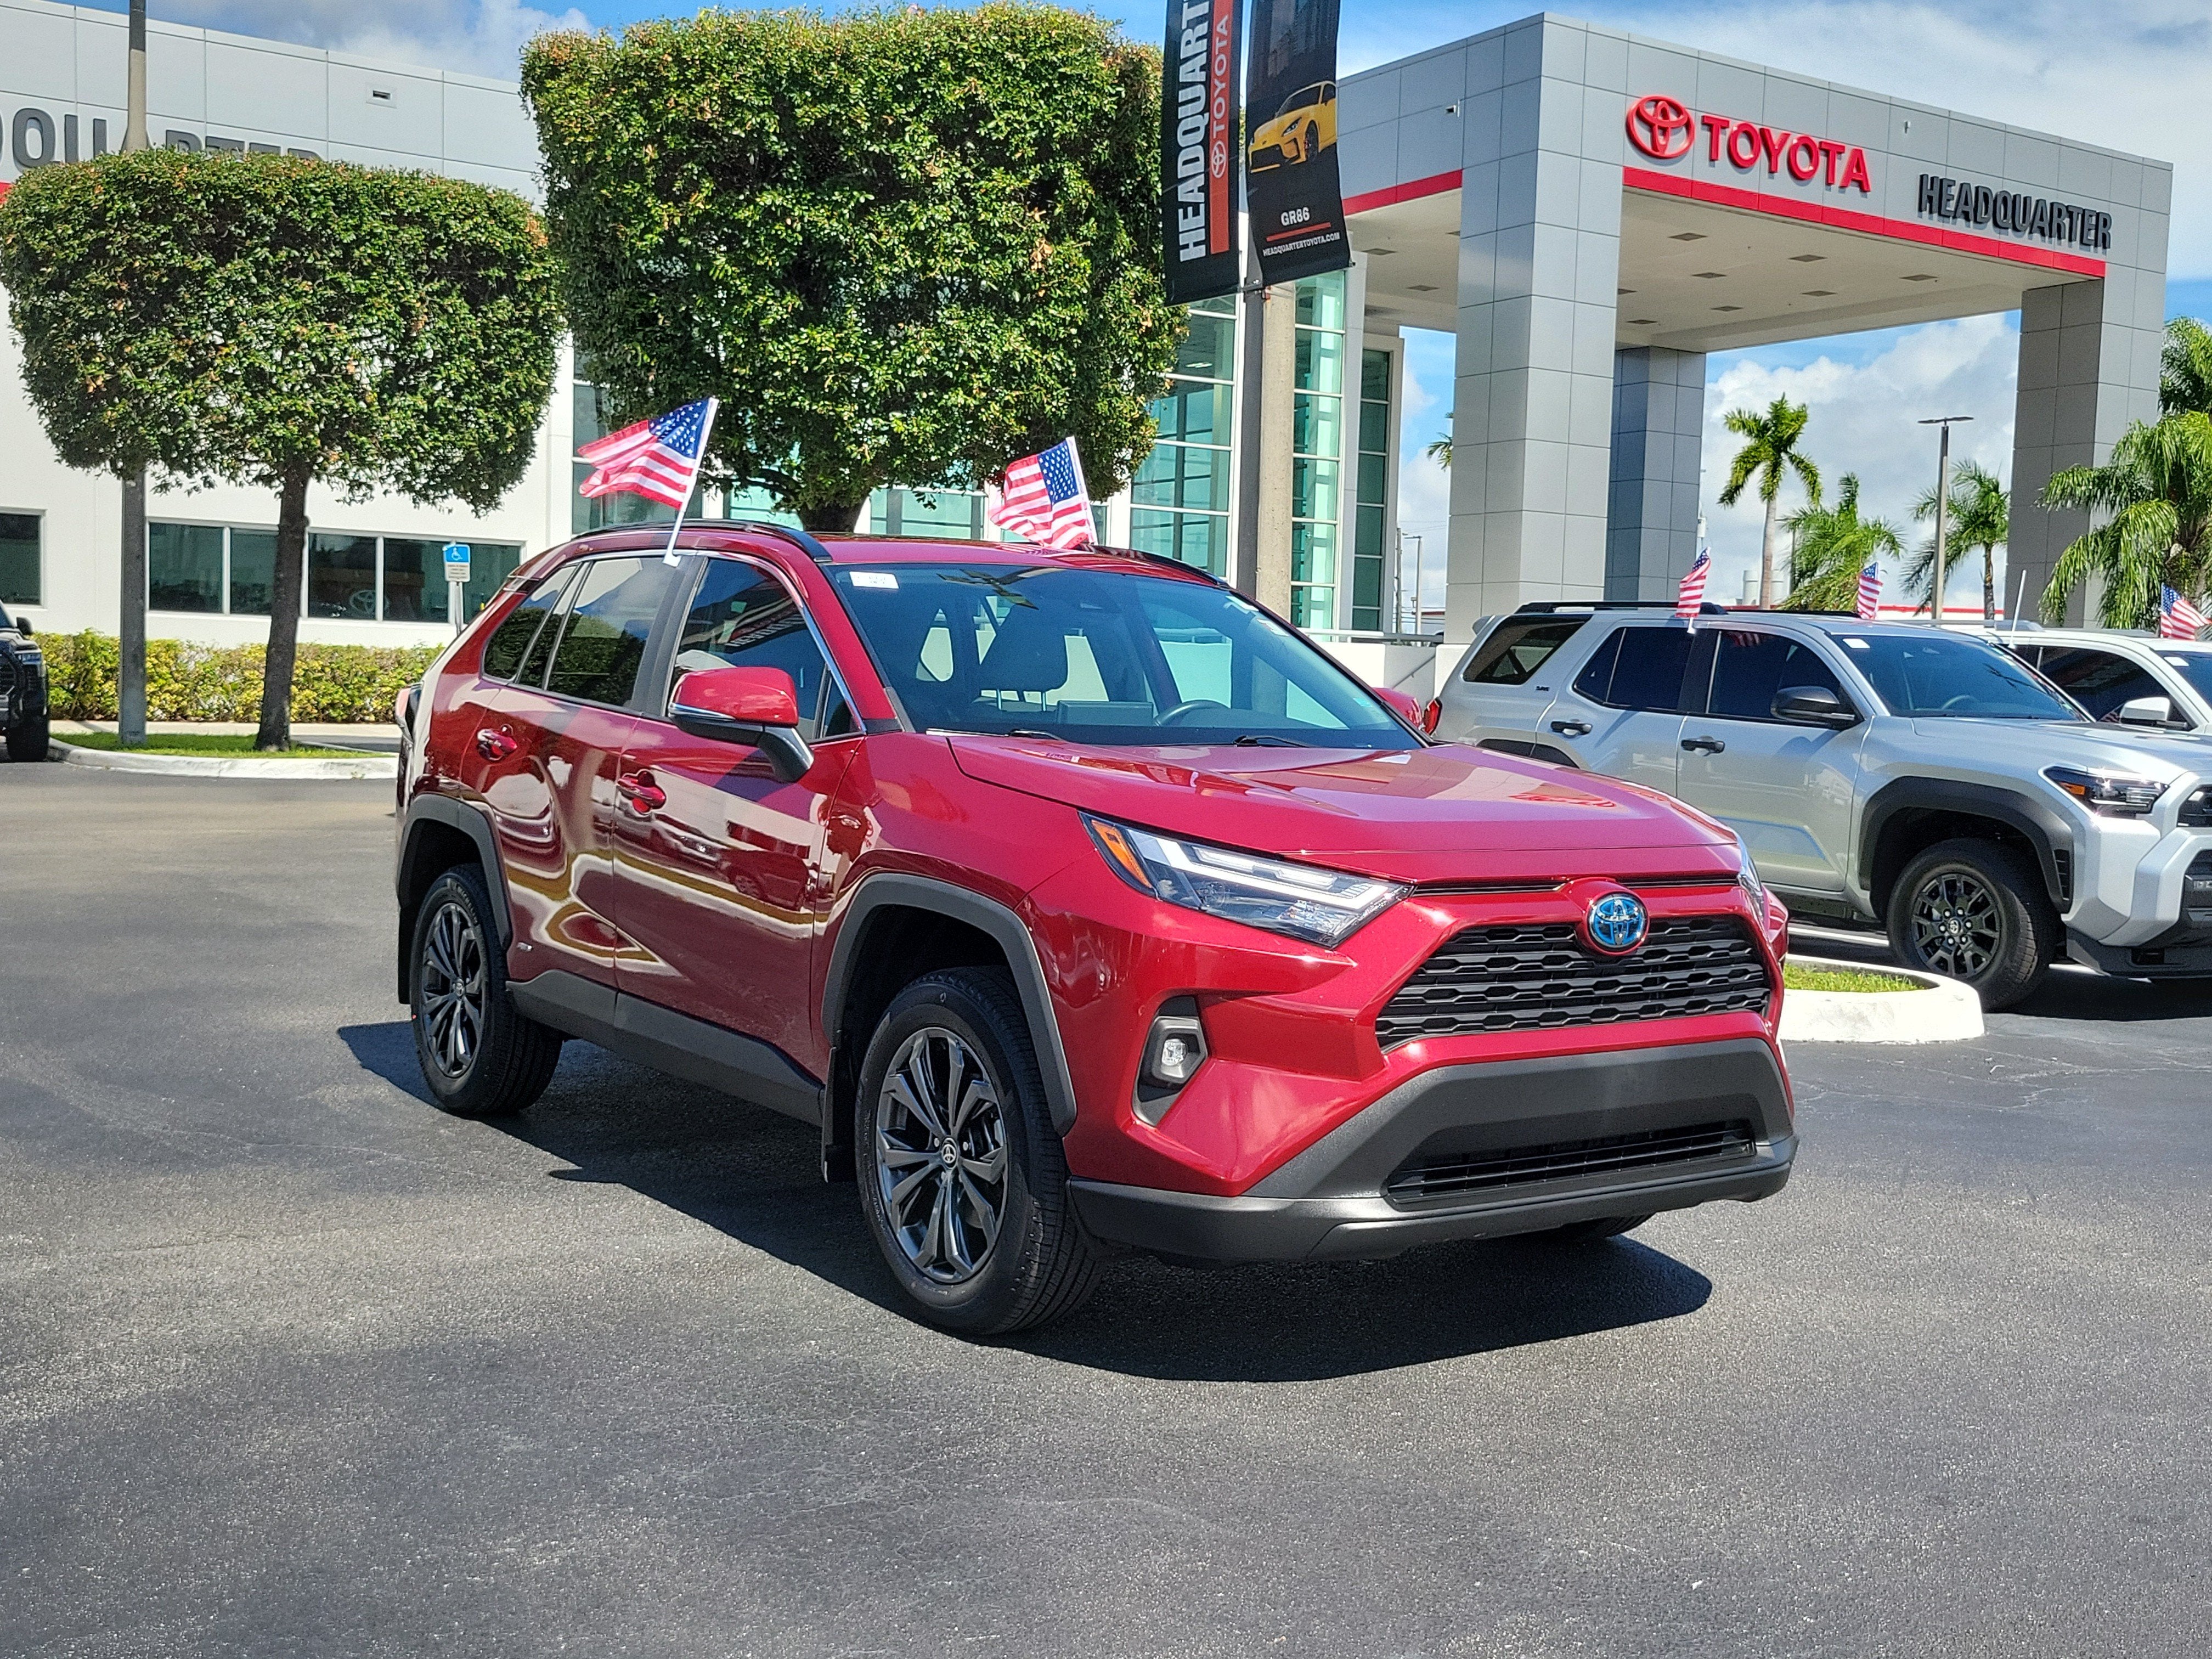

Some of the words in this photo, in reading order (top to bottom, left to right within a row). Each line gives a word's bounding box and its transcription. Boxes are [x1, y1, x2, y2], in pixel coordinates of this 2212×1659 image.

[1213, 14, 1229, 138] TOYOTA
[1177, 0, 1209, 262] HEADQUART
[1702, 115, 1870, 192] TOYOTA
[1263, 232, 1340, 257] HEADQUARTERTOYOTA.COM
[1281, 207, 1310, 226] GR86
[1919, 173, 2112, 249] HEADQUARTER
